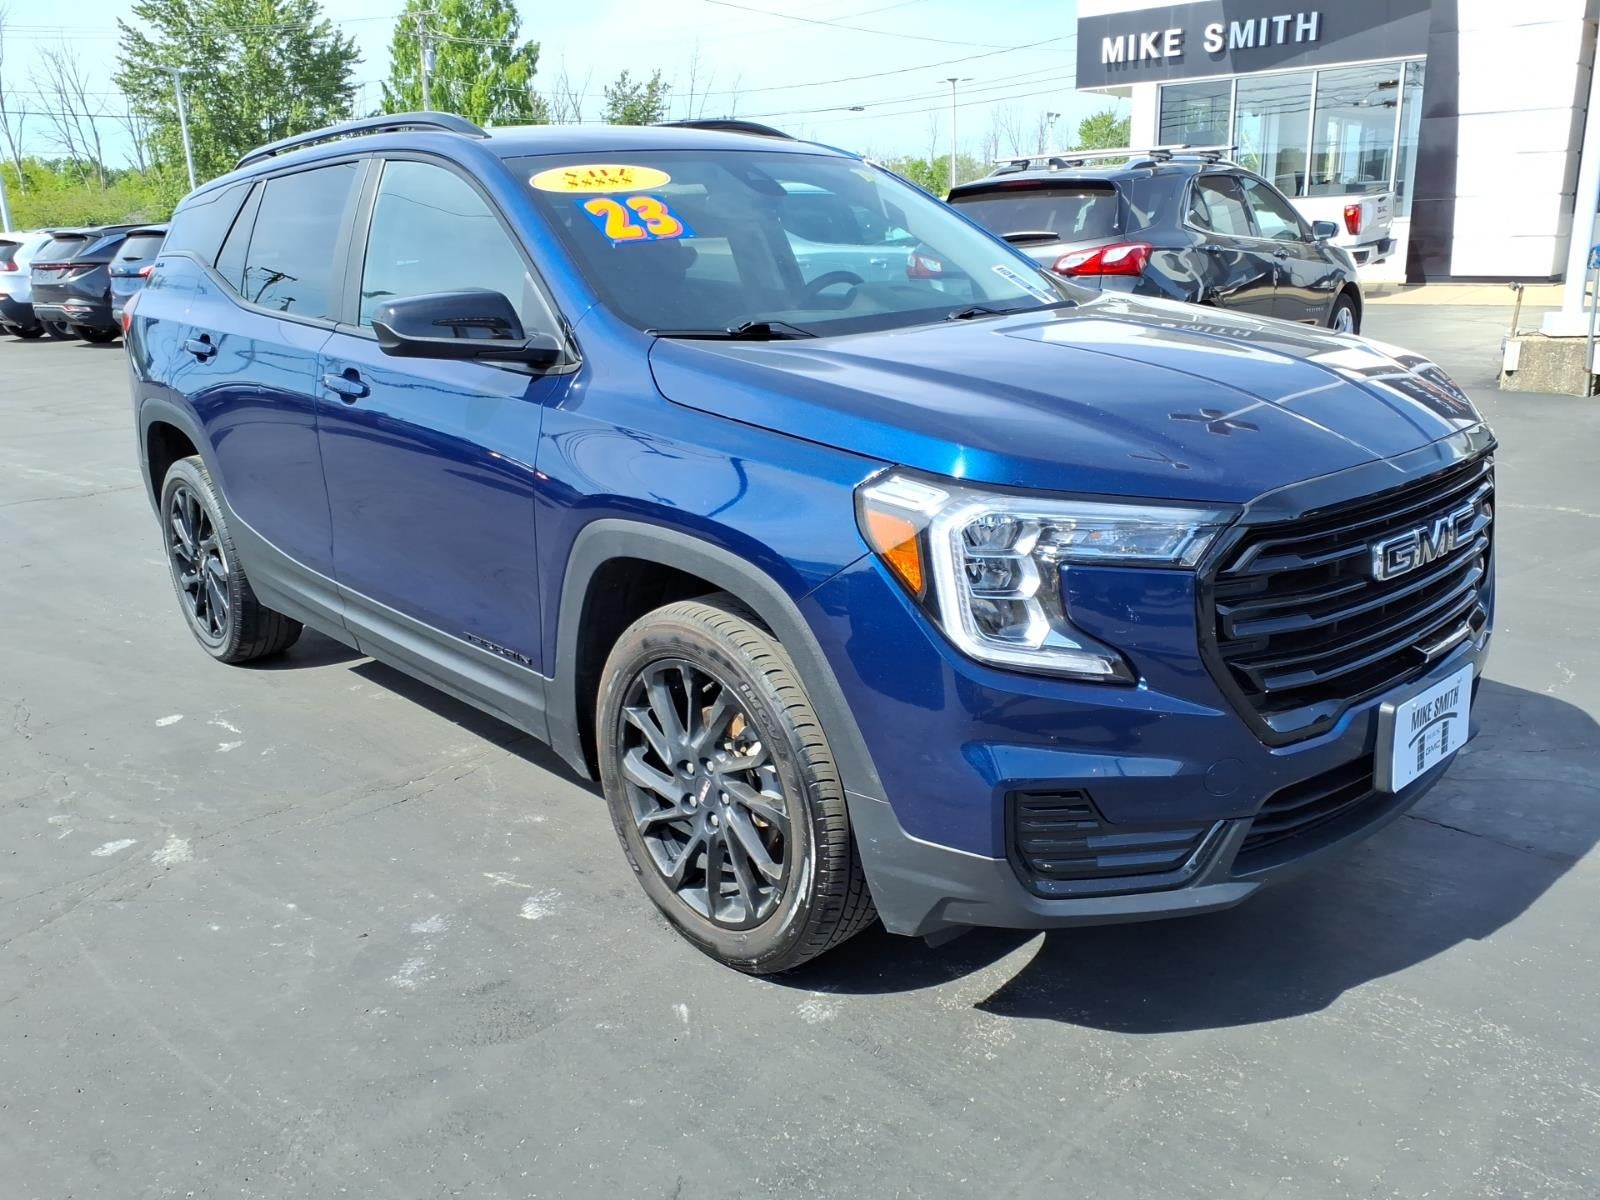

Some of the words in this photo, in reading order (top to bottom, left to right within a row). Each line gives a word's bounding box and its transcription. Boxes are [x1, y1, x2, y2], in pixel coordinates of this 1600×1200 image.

[1101, 28, 1183, 64] MIKE
[1203, 11, 1319, 53] SMITH
[583, 196, 684, 239] 23
[1372, 503, 1475, 582] GMC
[1410, 701, 1433, 733] MIKE
[1433, 685, 1460, 717] SMITH
